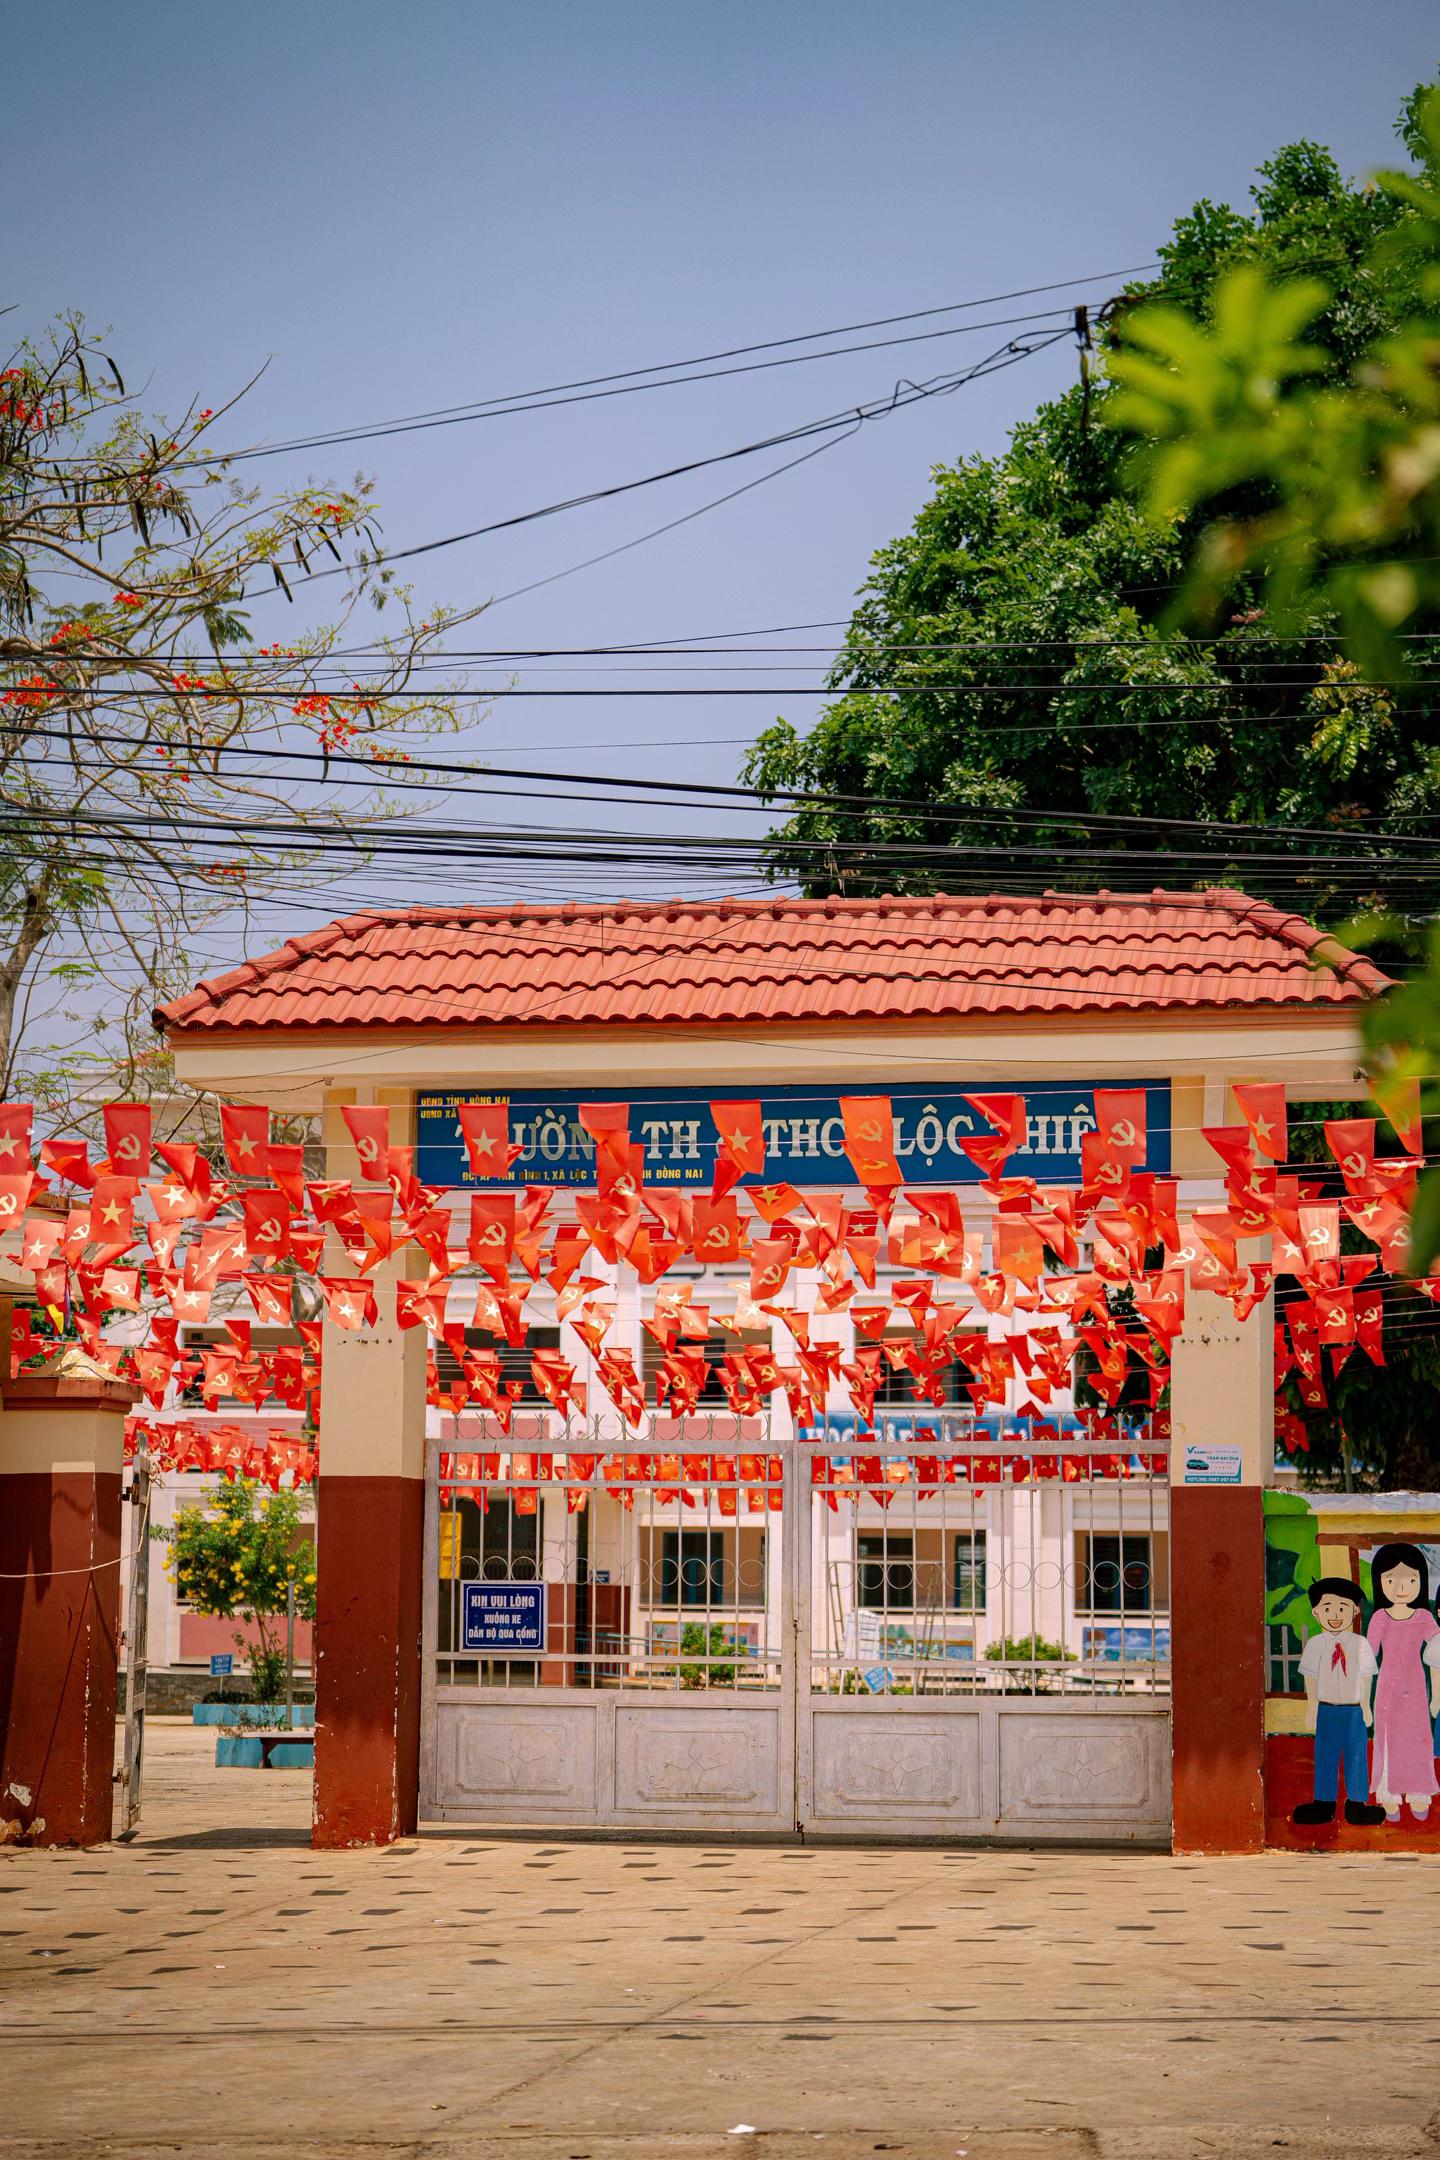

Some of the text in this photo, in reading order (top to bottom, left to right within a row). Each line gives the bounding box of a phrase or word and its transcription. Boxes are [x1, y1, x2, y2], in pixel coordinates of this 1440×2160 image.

[421, 1096, 443, 1106] UBND
[495, 1096, 510, 1105] NAI
[420, 1109, 443, 1118] UBND
[641, 1120, 701, 1159] TH
[762, 1117, 846, 1157] THC
[552, 1169, 566, 1181] XÃ
[685, 1168, 703, 1179] NAI
[471, 1593, 535, 1608] XIN VUI LÒNG
[484, 1611, 522, 1624] XUỐNG XE
[486, 1627, 497, 1640] BỘ
[499, 1629, 514, 1639] QUA
